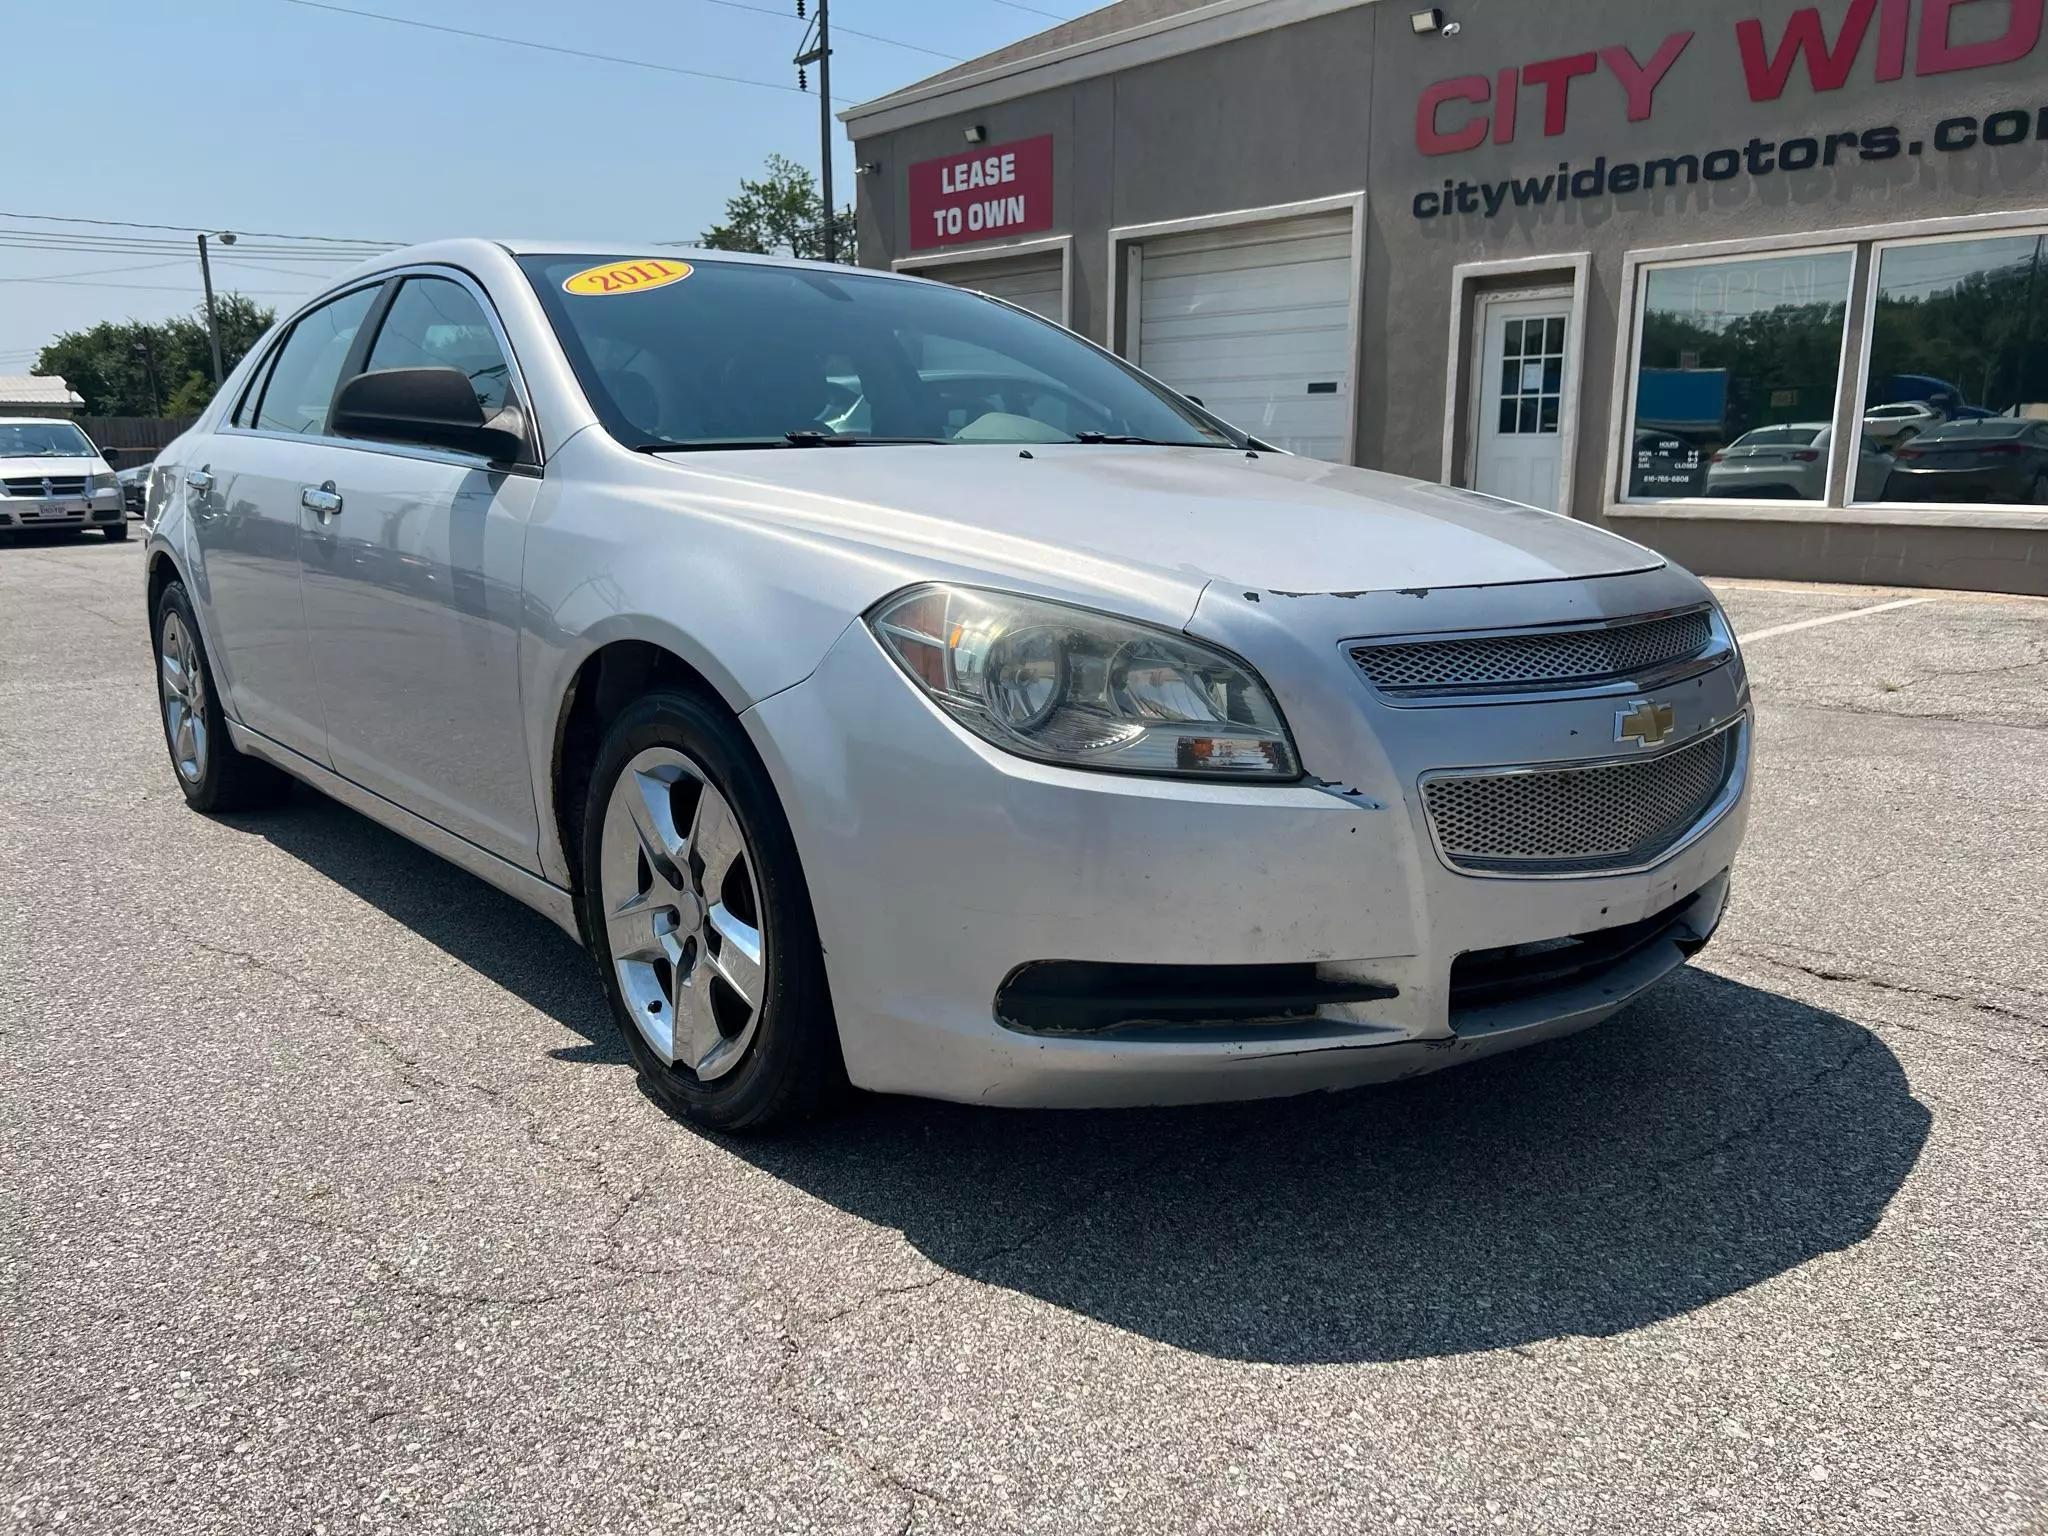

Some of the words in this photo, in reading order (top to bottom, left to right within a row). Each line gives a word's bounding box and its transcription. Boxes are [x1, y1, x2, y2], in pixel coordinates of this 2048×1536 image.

[1416, 31, 1696, 156] CITY
[942, 153, 1015, 195] LEASE
[1412, 106, 2048, 219] citywidemotors.co
[933, 207, 962, 236] TO
[968, 195, 1025, 231] OWN
[588, 262, 677, 291] 2011
[1659, 441, 1679, 449] HOURS
